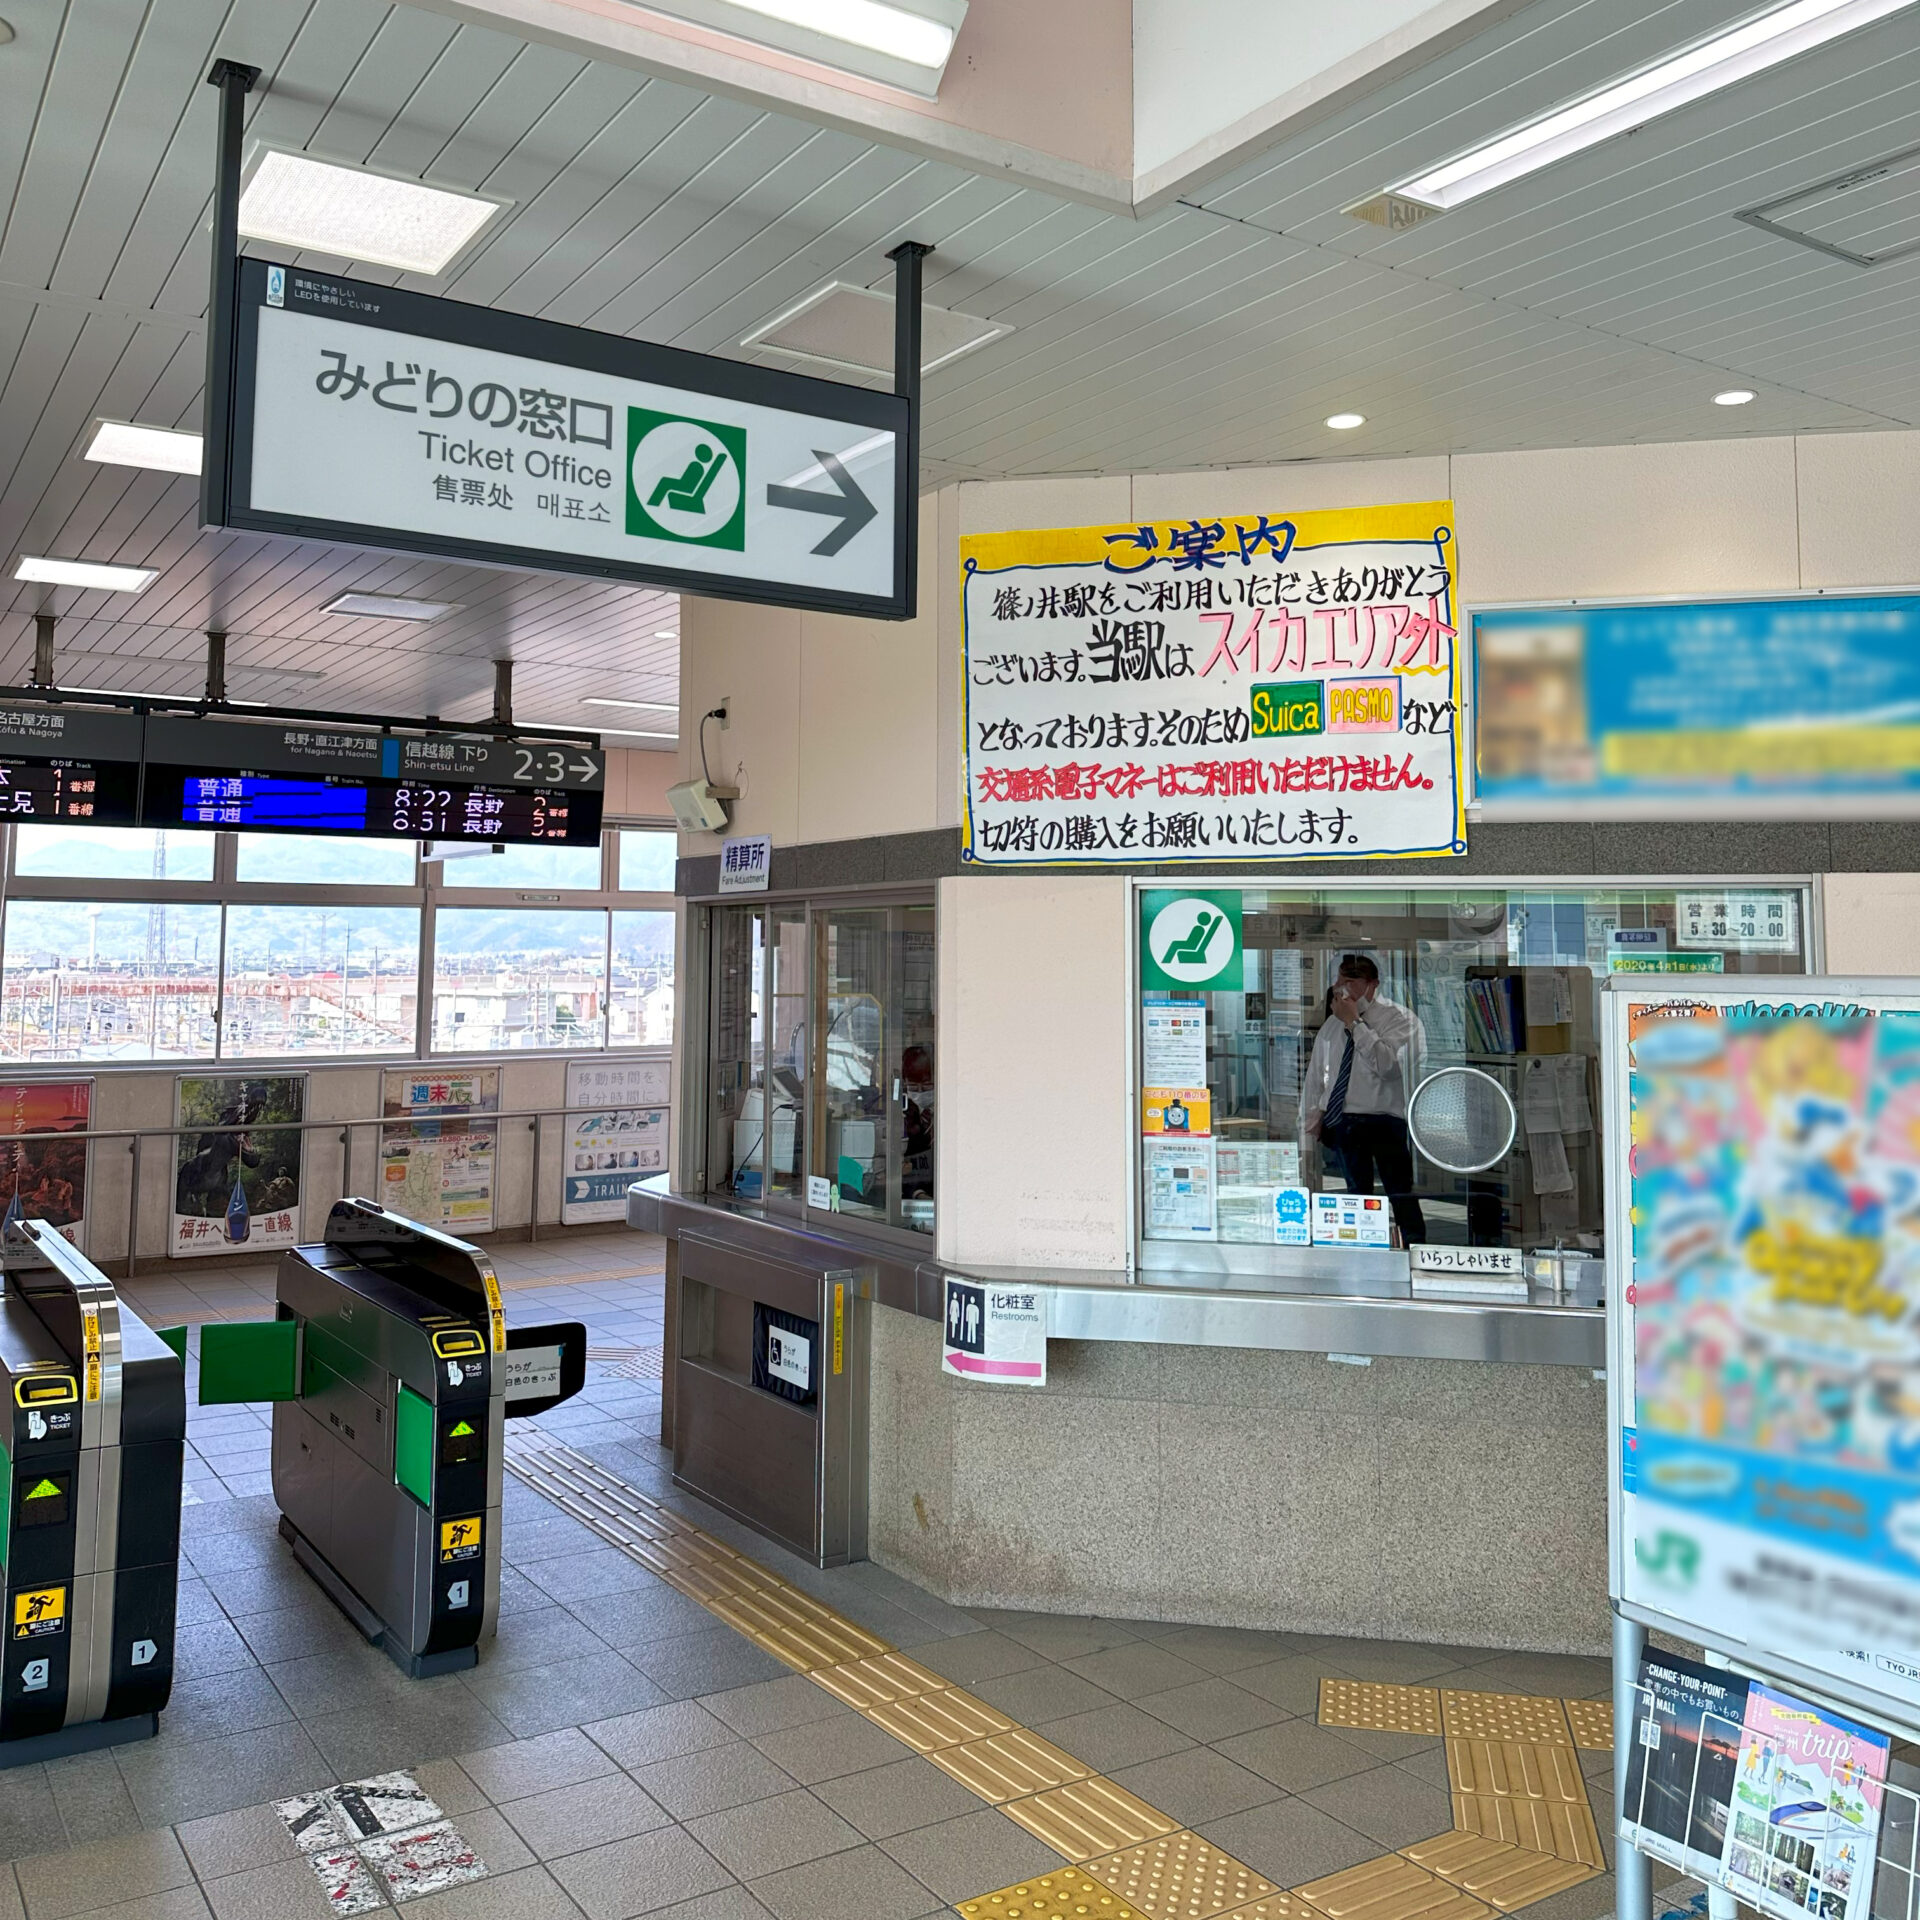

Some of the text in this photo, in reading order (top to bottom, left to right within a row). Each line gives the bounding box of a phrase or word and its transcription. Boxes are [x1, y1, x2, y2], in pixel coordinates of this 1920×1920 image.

[295, 279, 356, 297] 環境にやさしい
[294, 290, 381, 313] LEDを使用しています
[316, 349, 613, 450] みどりの窓口
[418, 431, 612, 489] Ticket Office
[432, 473, 514, 511] 售票处
[537, 493, 611, 524] 매표소
[1102, 516, 1298, 571] ご案内
[991, 565, 1452, 619] 篠ノ井駅をご利用いただきありがとう
[1253, 691, 1321, 734] Suica
[1330, 688, 1394, 725] PASMO
[1403, 699, 1457, 736] など
[28, 728, 63, 738] Nagoya
[305, 748, 335, 757] Nagano
[405, 741, 488, 762] 信越線 下り
[404, 760, 475, 773] Shin-etsu Line
[976, 754, 1434, 804] 交通系電子マネーはご利用いただけません。
[198, 778, 243, 798] 普通
[464, 792, 504, 814] 長野
[462, 813, 503, 835] 長野
[978, 808, 1359, 852] 切符の購入をお願いいたします。
[725, 842, 764, 873] 精算所
[722, 873, 765, 884] Fare Adjustment
[1687, 903, 1783, 920] 営業時間
[179, 1212, 293, 1240] 福井へ 一直線
[1420, 1250, 1512, 1269] いらっしゃいませ
[991, 1292, 1036, 1311] 化粧室
[992, 1310, 1040, 1323] Restrooms
[50, 1412, 71, 1423] きっぷ
[50, 1422, 71, 1430] TICKET
[456, 1586, 463, 1598] 1
[138, 1645, 145, 1659] 1
[32, 1665, 43, 1680] 2
[1886, 1660, 1905, 1673] TYO
[1656, 1698, 1677, 1716] MALL
[1802, 1728, 1852, 1772] trip
